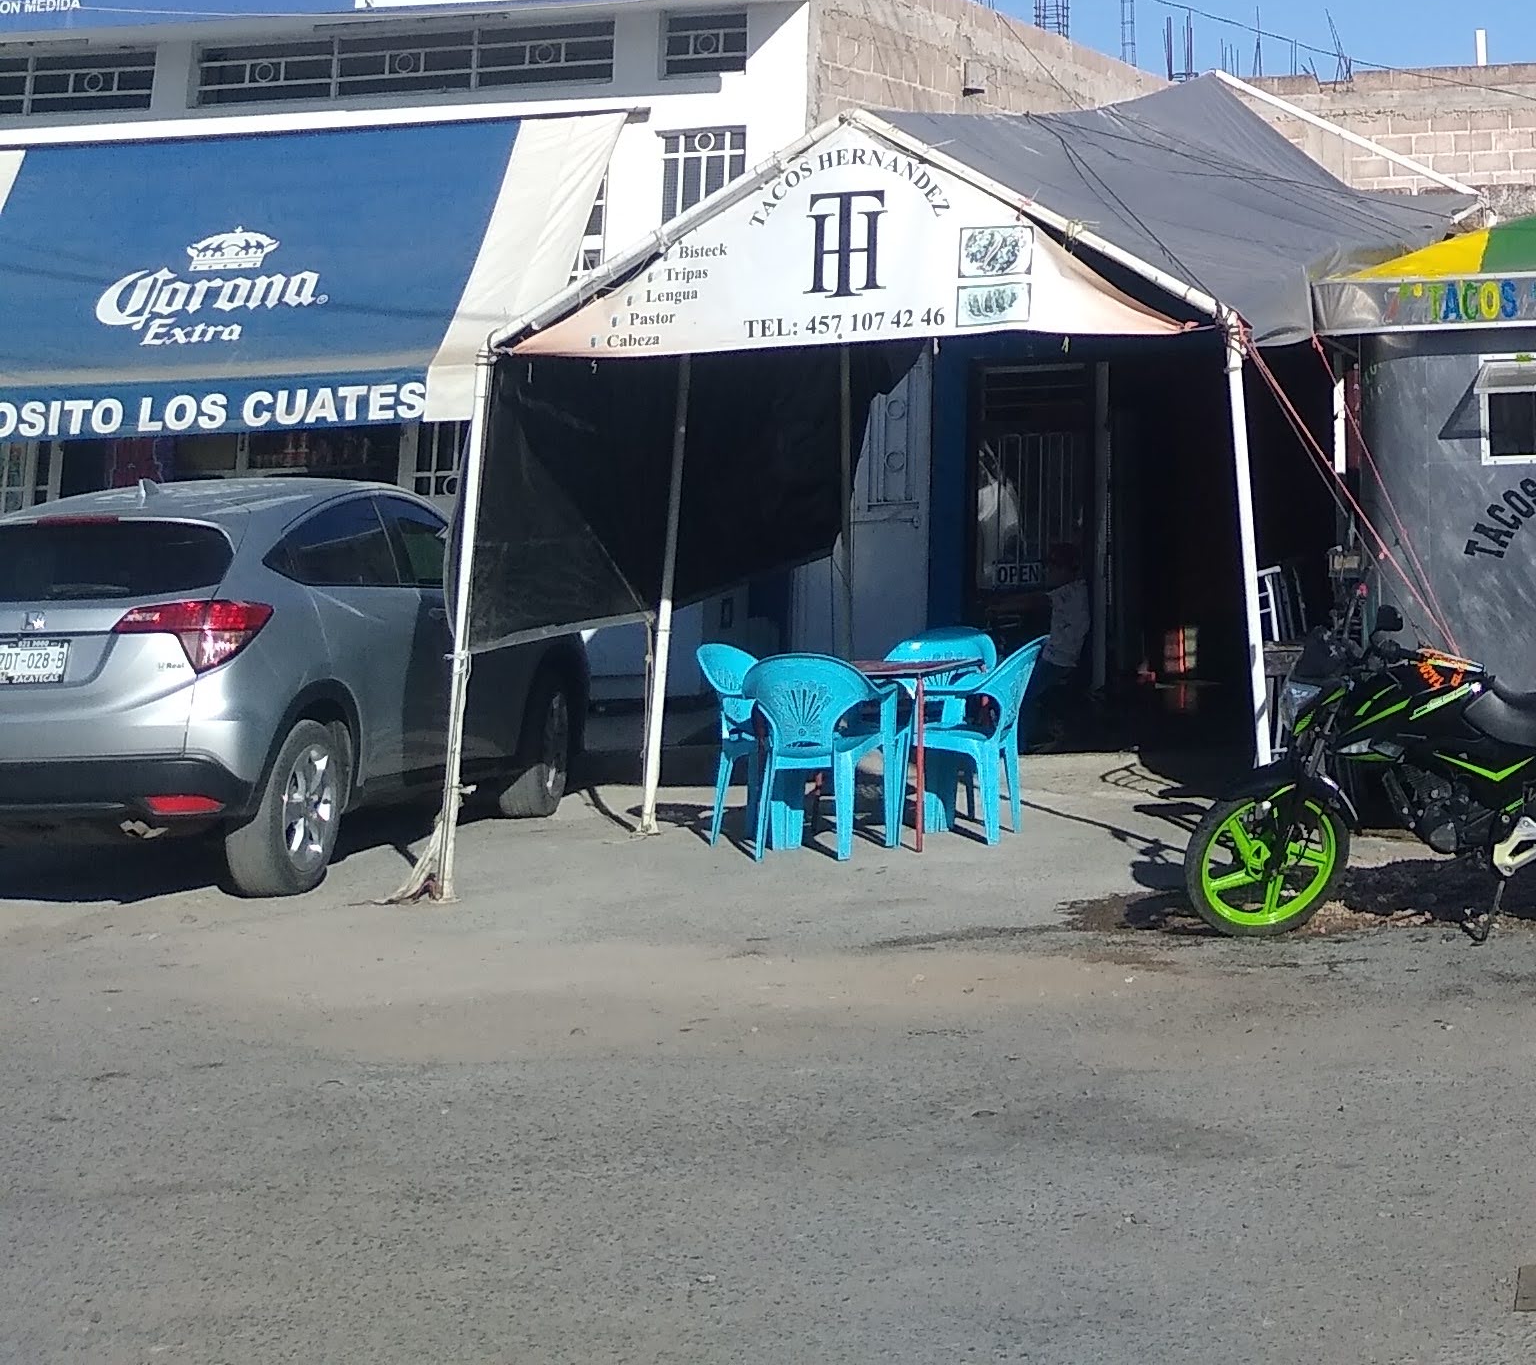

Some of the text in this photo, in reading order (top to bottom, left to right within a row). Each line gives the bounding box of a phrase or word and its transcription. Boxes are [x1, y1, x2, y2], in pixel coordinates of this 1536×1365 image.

[749, 148, 951, 227] TACOS HERNANDEZ
[679, 243, 728, 259] Bisteck
[665, 267, 709, 284] Tripas
[95, 268, 320, 330] Corona
[646, 289, 698, 305] Lengua
[629, 312, 676, 326] Pastor
[744, 307, 945, 339] TEL: 457 107 42 46
[140, 317, 242, 346] Extra
[606, 333, 660, 348] Cabeza
[138, 392, 228, 433] LOS
[243, 382, 427, 424] CUATES
[999, 566, 1039, 583] OPEN
